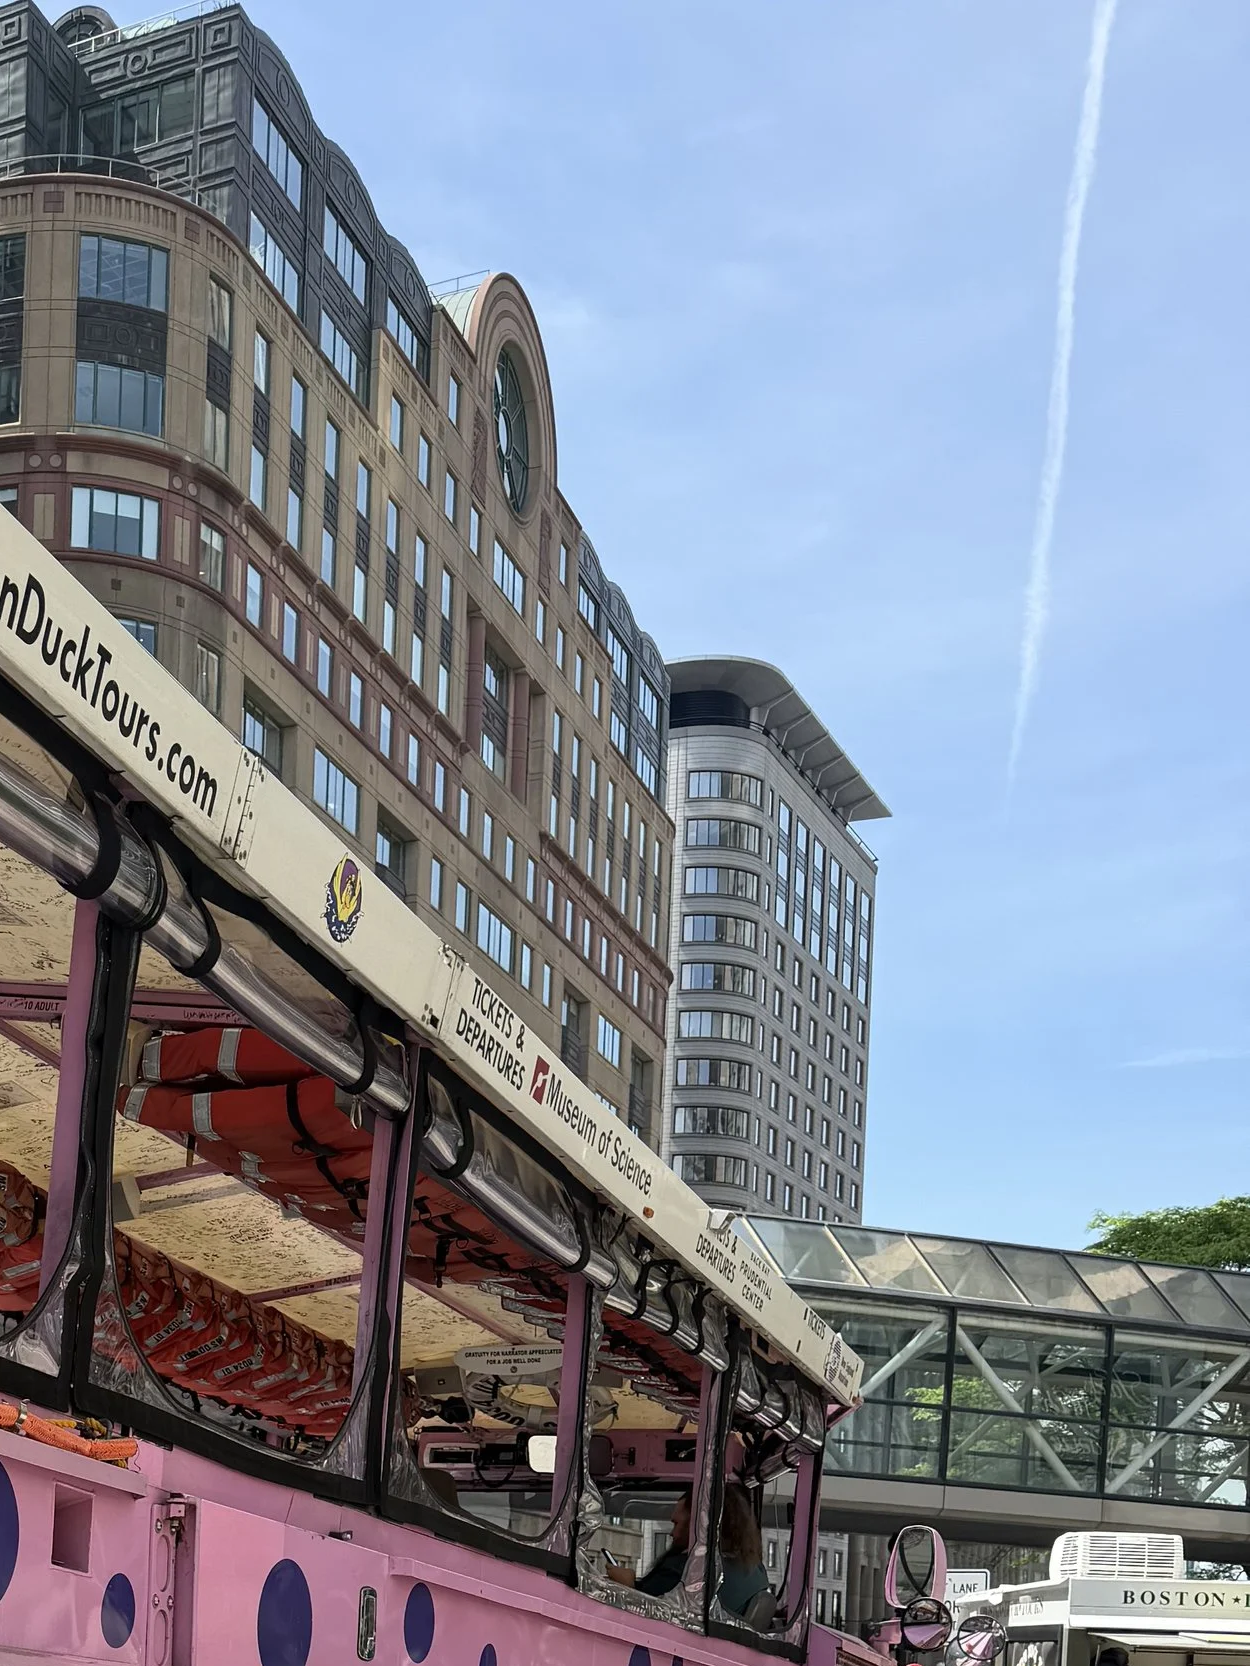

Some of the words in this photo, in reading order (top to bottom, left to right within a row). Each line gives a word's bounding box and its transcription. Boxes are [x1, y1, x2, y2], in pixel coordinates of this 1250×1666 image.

[34, 1001, 59, 1011] ADULT
[472, 977, 515, 1039] TICKETS
[516, 1024, 525, 1052] &
[456, 1008, 526, 1091] DEPARTURES
[546, 1073, 597, 1147] Museum
[598, 1129, 613, 1160] of
[611, 1136, 652, 1196] Science
[695, 1233, 737, 1283] DEPARTURES
[731, 1236, 738, 1256] &
[739, 1260, 773, 1300] PRUDENTIAL
[741, 1284, 764, 1312] CENTER
[807, 1310, 826, 1340] TICKETS
[953, 1583, 978, 1594] LANE
[1122, 1590, 1226, 1607] BOSTON
